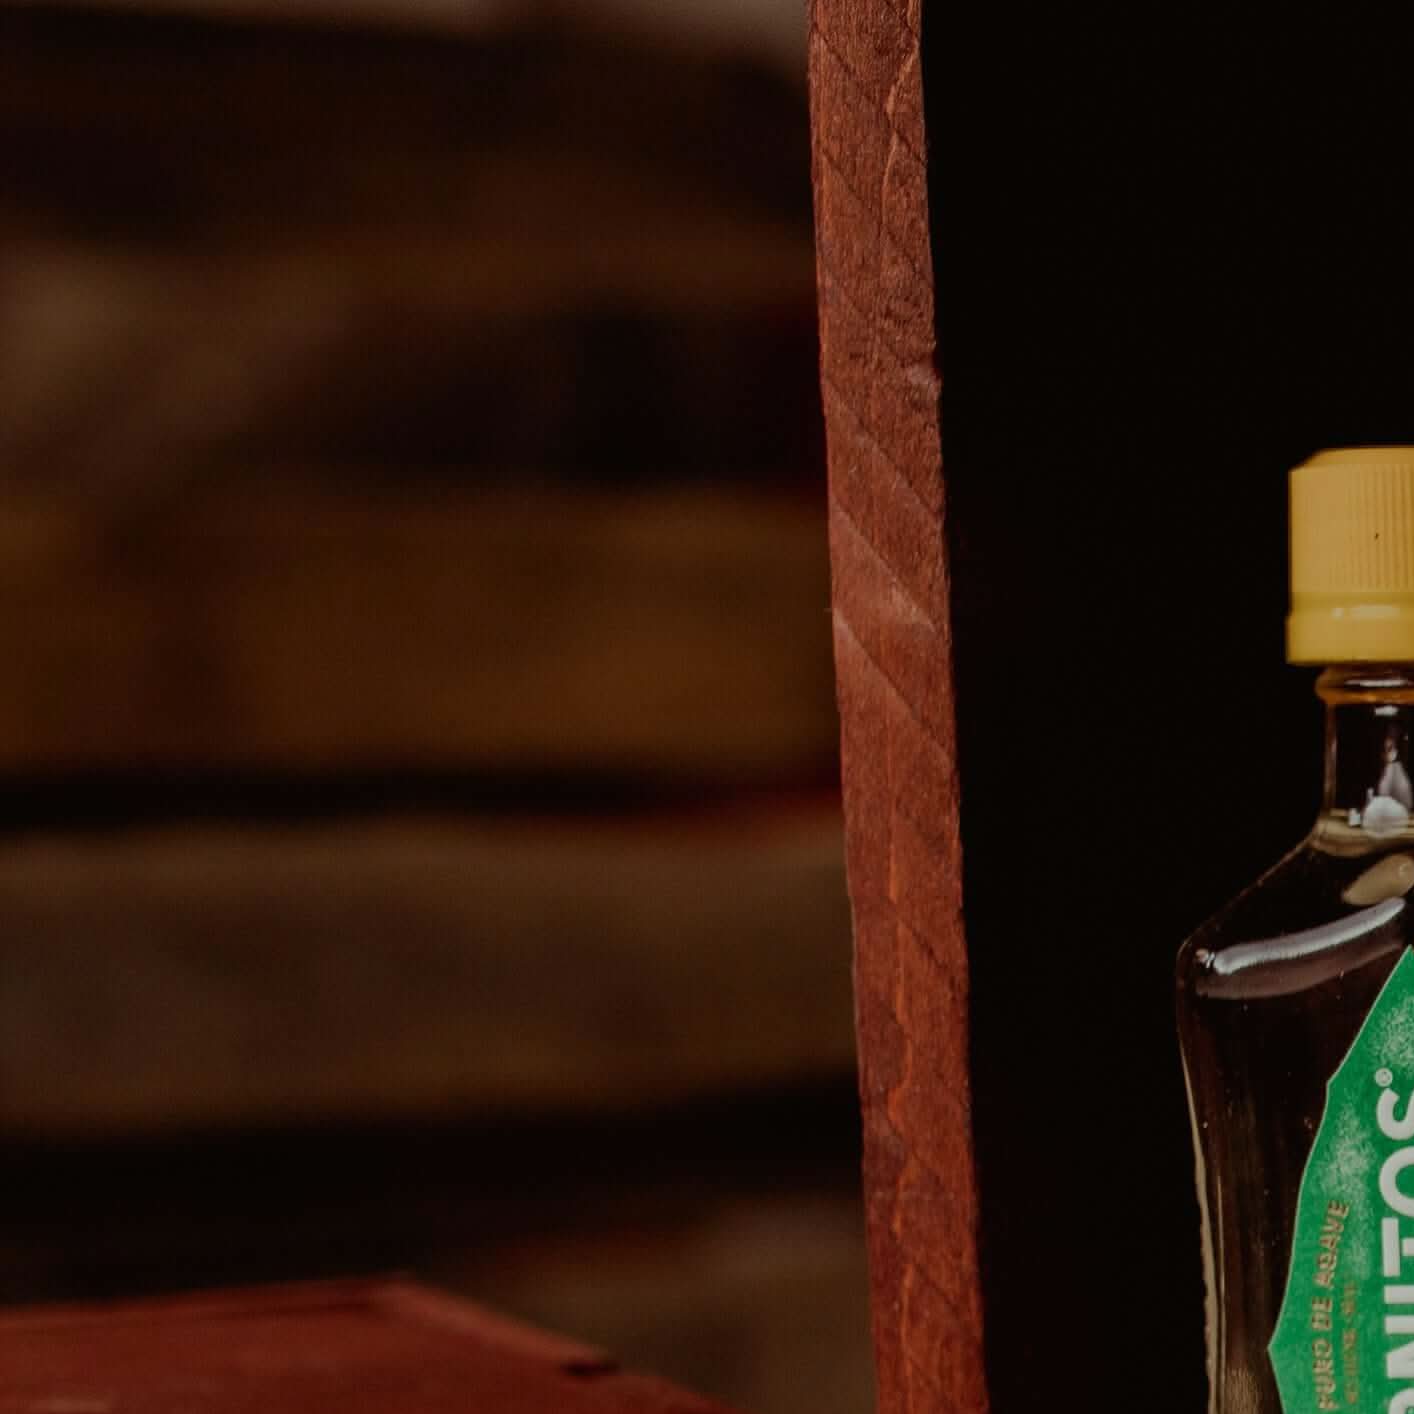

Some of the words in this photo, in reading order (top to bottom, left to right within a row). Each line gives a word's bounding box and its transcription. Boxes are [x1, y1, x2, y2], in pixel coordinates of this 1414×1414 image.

[1314, 1200, 1350, 1291] AGAVE
[1311, 1296, 1333, 1332] DE
[1311, 1339, 1337, 1412] PURO
